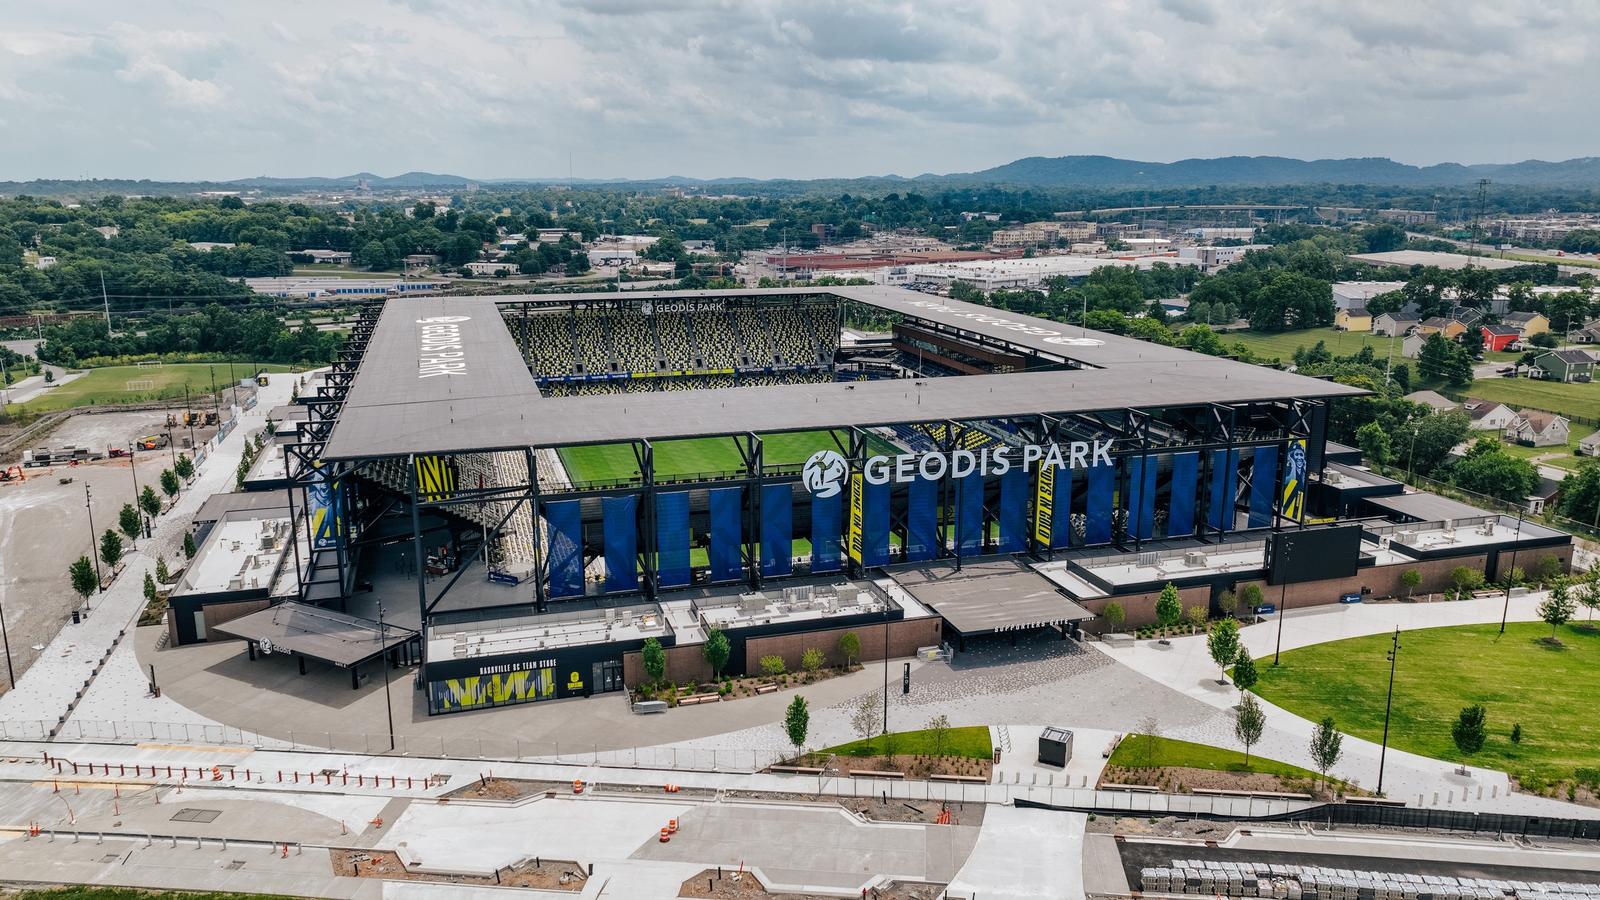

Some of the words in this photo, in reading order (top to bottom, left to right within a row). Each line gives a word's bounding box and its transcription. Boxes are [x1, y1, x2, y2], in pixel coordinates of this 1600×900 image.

[656, 303, 695, 313] GEODIS
[697, 302, 723, 312] PARK
[421, 324, 462, 351] GEODIS
[418, 351, 467, 379] PARK
[864, 447, 1010, 485] GEODIS
[1023, 438, 1114, 473] PARK
[1039, 495, 1052, 511] IN
[853, 513, 862, 530] ON
[1038, 510, 1052, 539] GOLD
[852, 531, 862, 554] YOU
[994, 620, 1046, 633] SUPPORTERS
[1049, 618, 1069, 626] GATE
[512, 662, 520, 671] SC
[522, 661, 537, 670] TEAM
[539, 658, 557, 668] STORE
